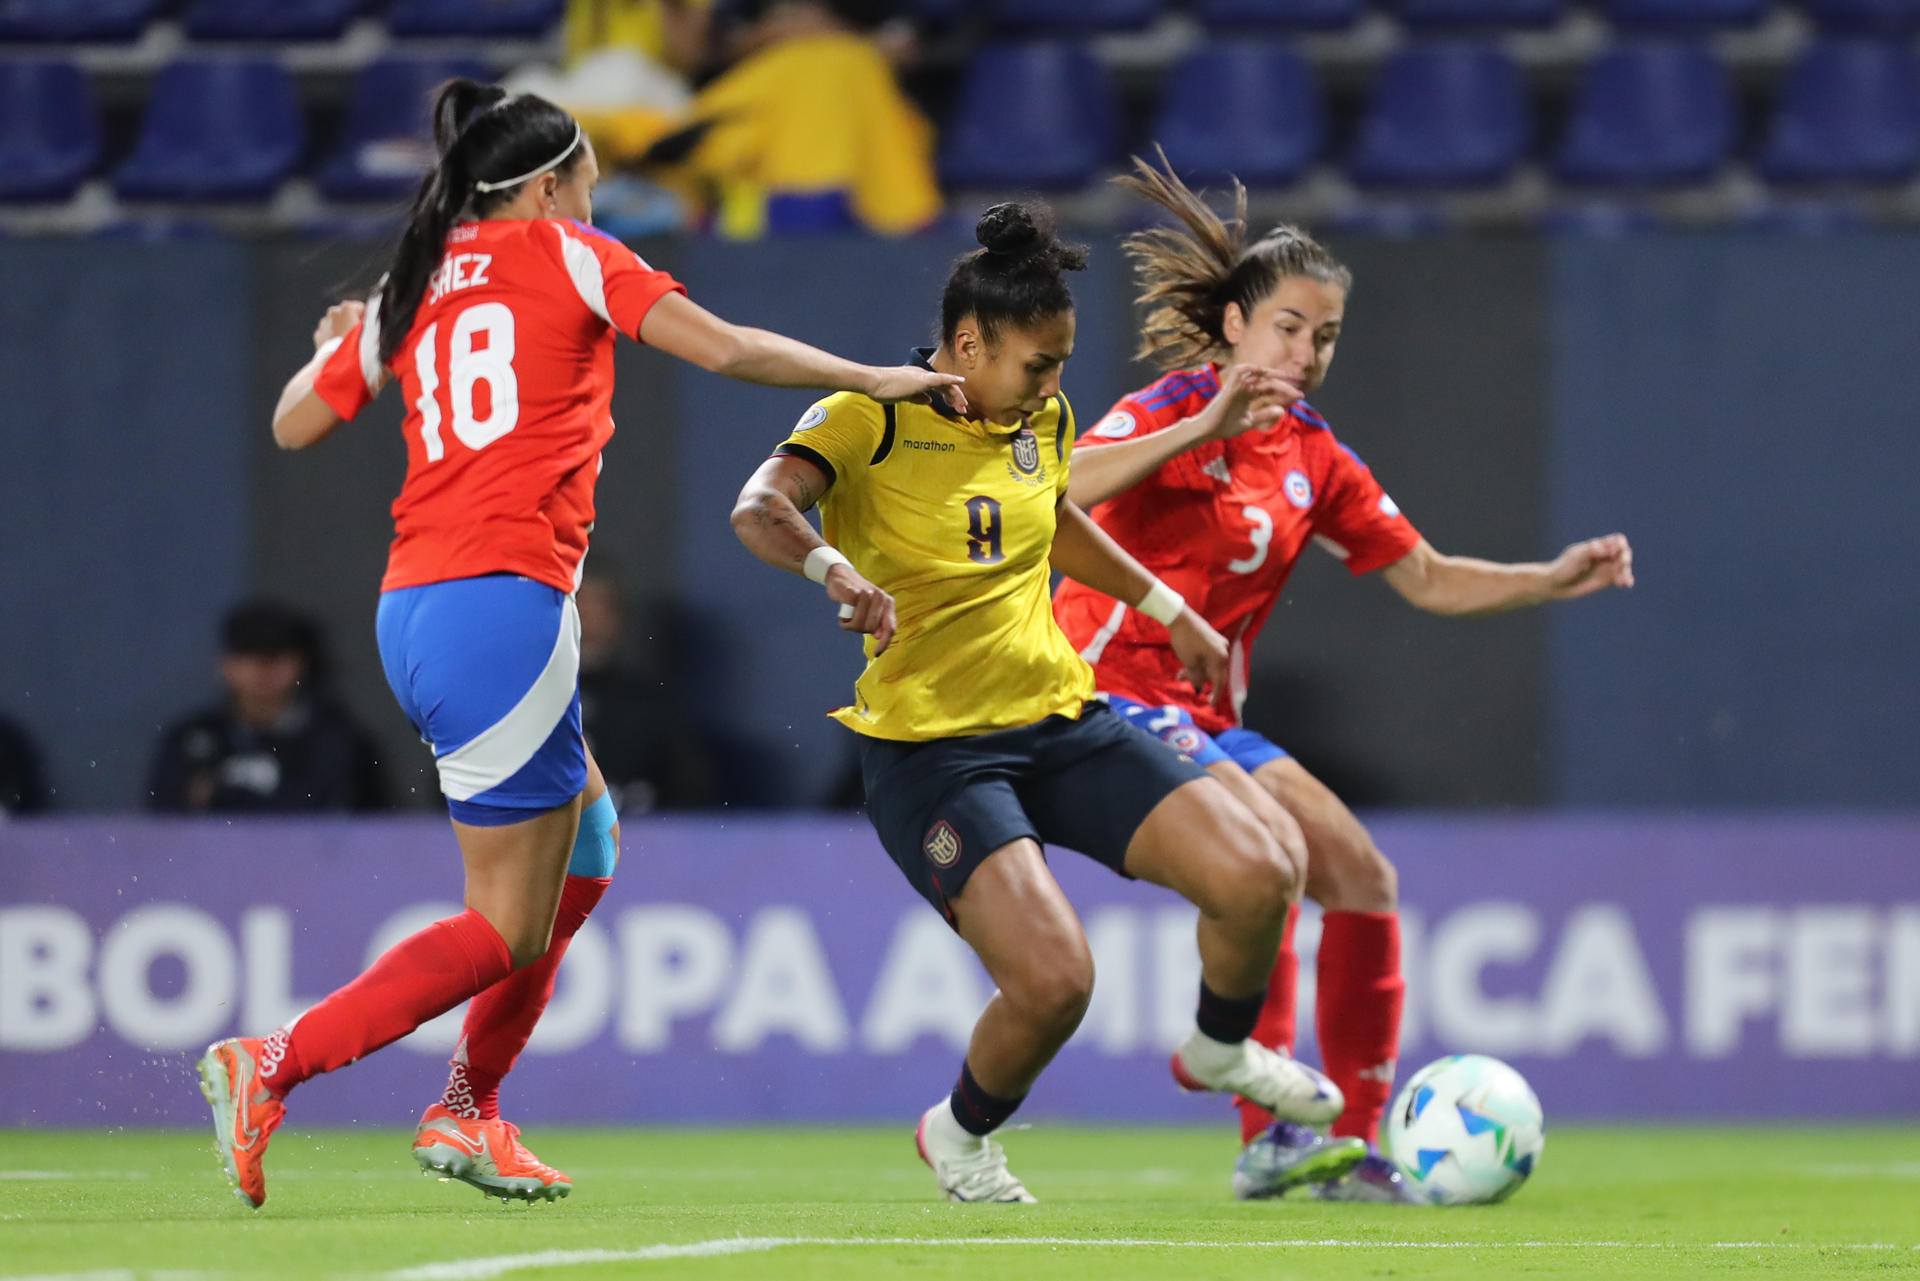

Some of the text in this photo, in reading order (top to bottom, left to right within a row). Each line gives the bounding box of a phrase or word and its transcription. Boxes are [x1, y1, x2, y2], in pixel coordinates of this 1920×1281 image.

[414, 302, 519, 463] 18
[903, 438, 955, 452] marathon
[964, 495, 1006, 565] 9
[1228, 505, 1273, 574] 3
[0, 902, 325, 1052] BOL
